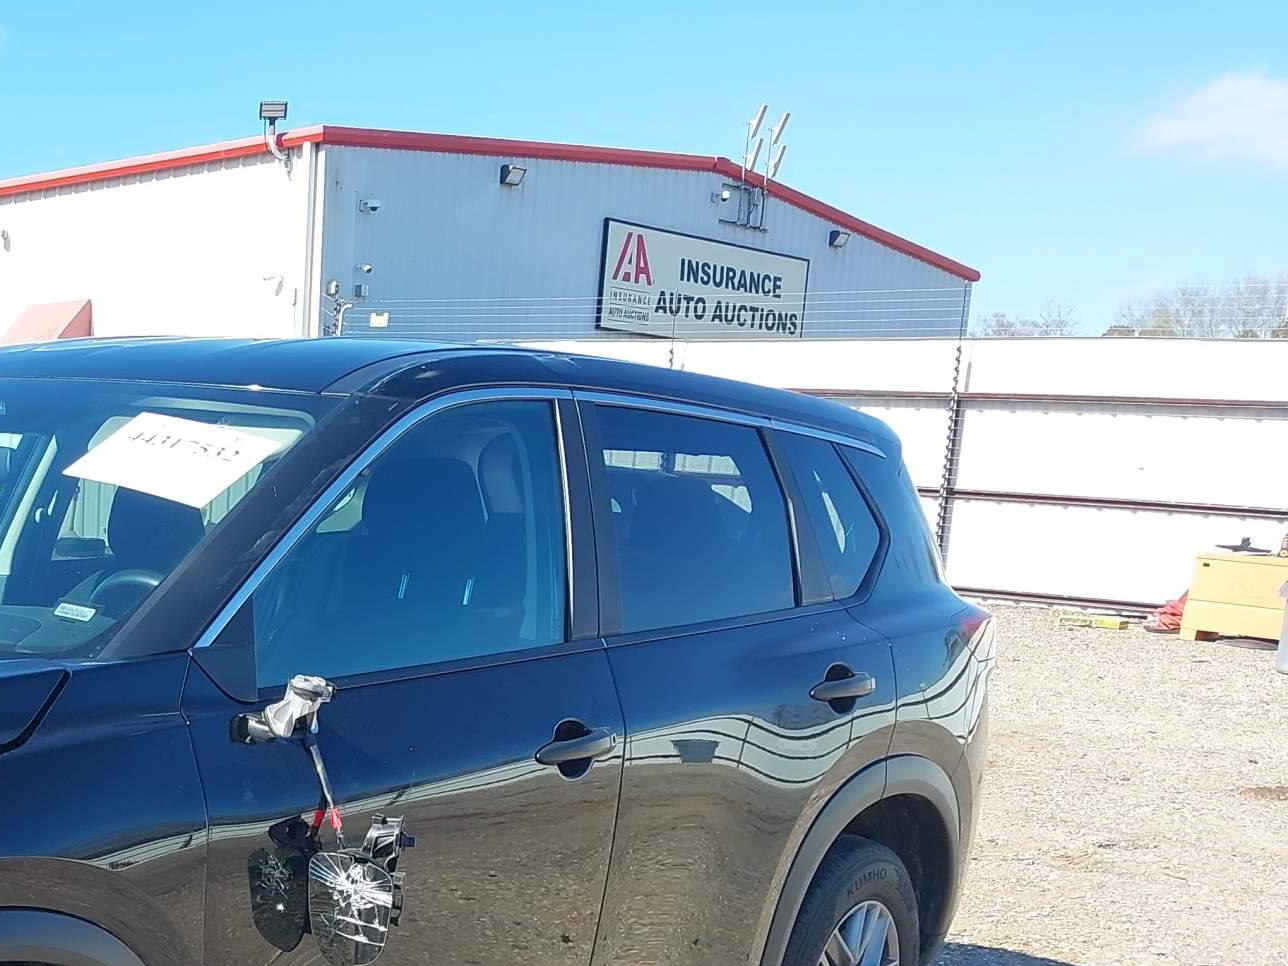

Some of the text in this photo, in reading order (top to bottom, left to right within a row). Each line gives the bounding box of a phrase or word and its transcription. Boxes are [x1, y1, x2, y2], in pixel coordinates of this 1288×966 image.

[680, 258, 783, 299] INSURANCE
[609, 290, 651, 306] INSURANCE
[608, 306, 650, 322] AUTO AUCTIONS
[655, 291, 798, 336] AUTO AUCTIONS
